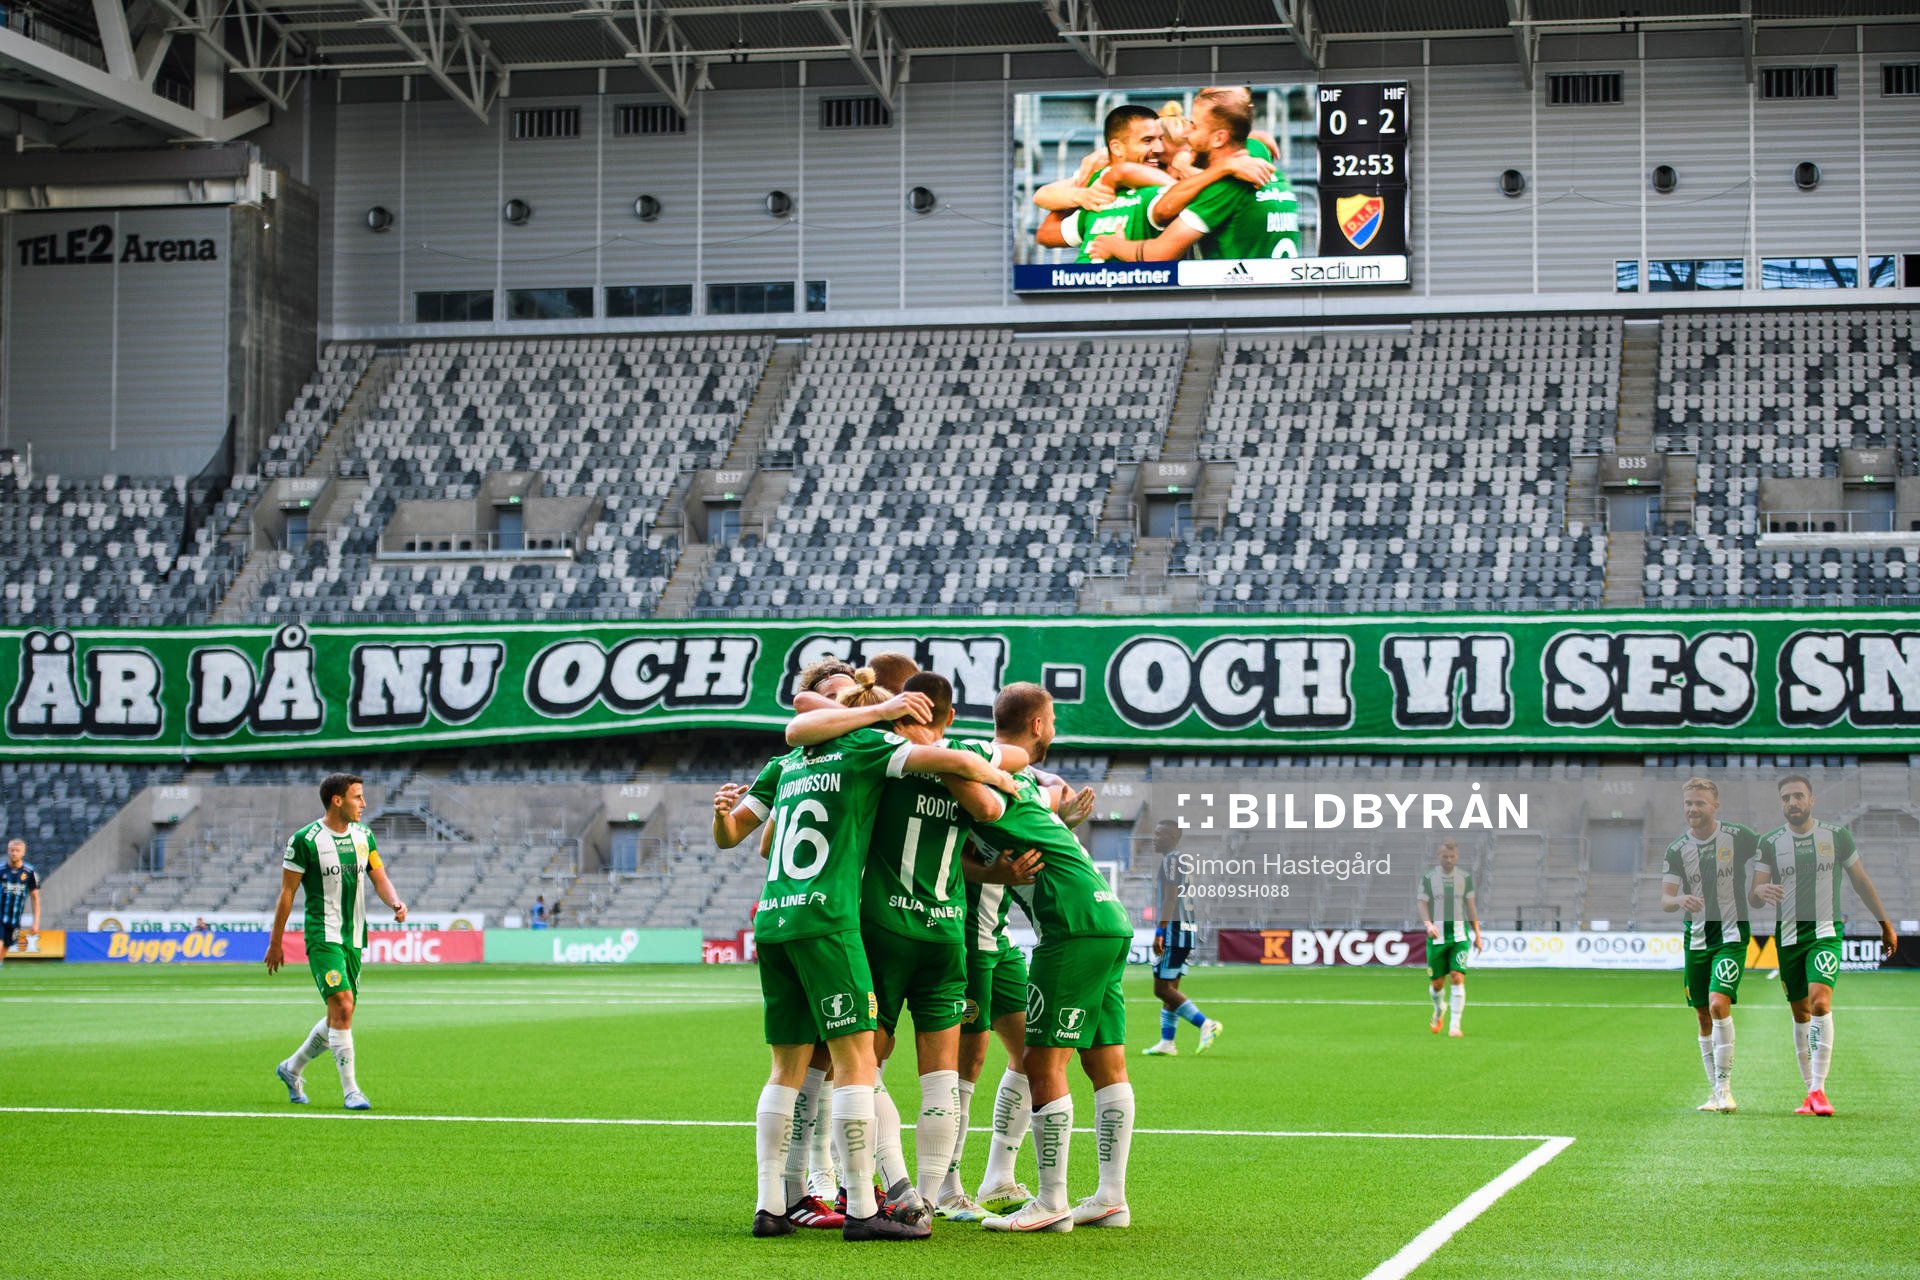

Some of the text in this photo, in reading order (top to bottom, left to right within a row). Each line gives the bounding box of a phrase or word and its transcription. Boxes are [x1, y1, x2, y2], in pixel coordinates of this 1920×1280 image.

[1320, 87, 1406, 102] DIF HIF
[1329, 110, 1347, 135] 0
[1379, 108, 1396, 134] 2
[1333, 154, 1394, 176] 32:53
[17, 224, 217, 266] TELE2 Arena
[1052, 268, 1171, 287] Huvudpartner
[1290, 262, 1381, 281] stadium
[9, 630, 162, 738] ÄR
[188, 624, 323, 738] DÅ
[349, 643, 503, 730] NU
[525, 638, 759, 718] OCH
[1107, 635, 1353, 730] OCH
[1381, 633, 1513, 729] VI
[1543, 631, 1757, 728] SES
[779, 773, 841, 801] LUDWIGSON
[768, 798, 830, 882] 16
[780, 894, 807, 908] LINE
[888, 895, 925, 913] SILJA
[553, 936, 628, 963] Lendo
[826, 1016, 857, 1029] fronta
